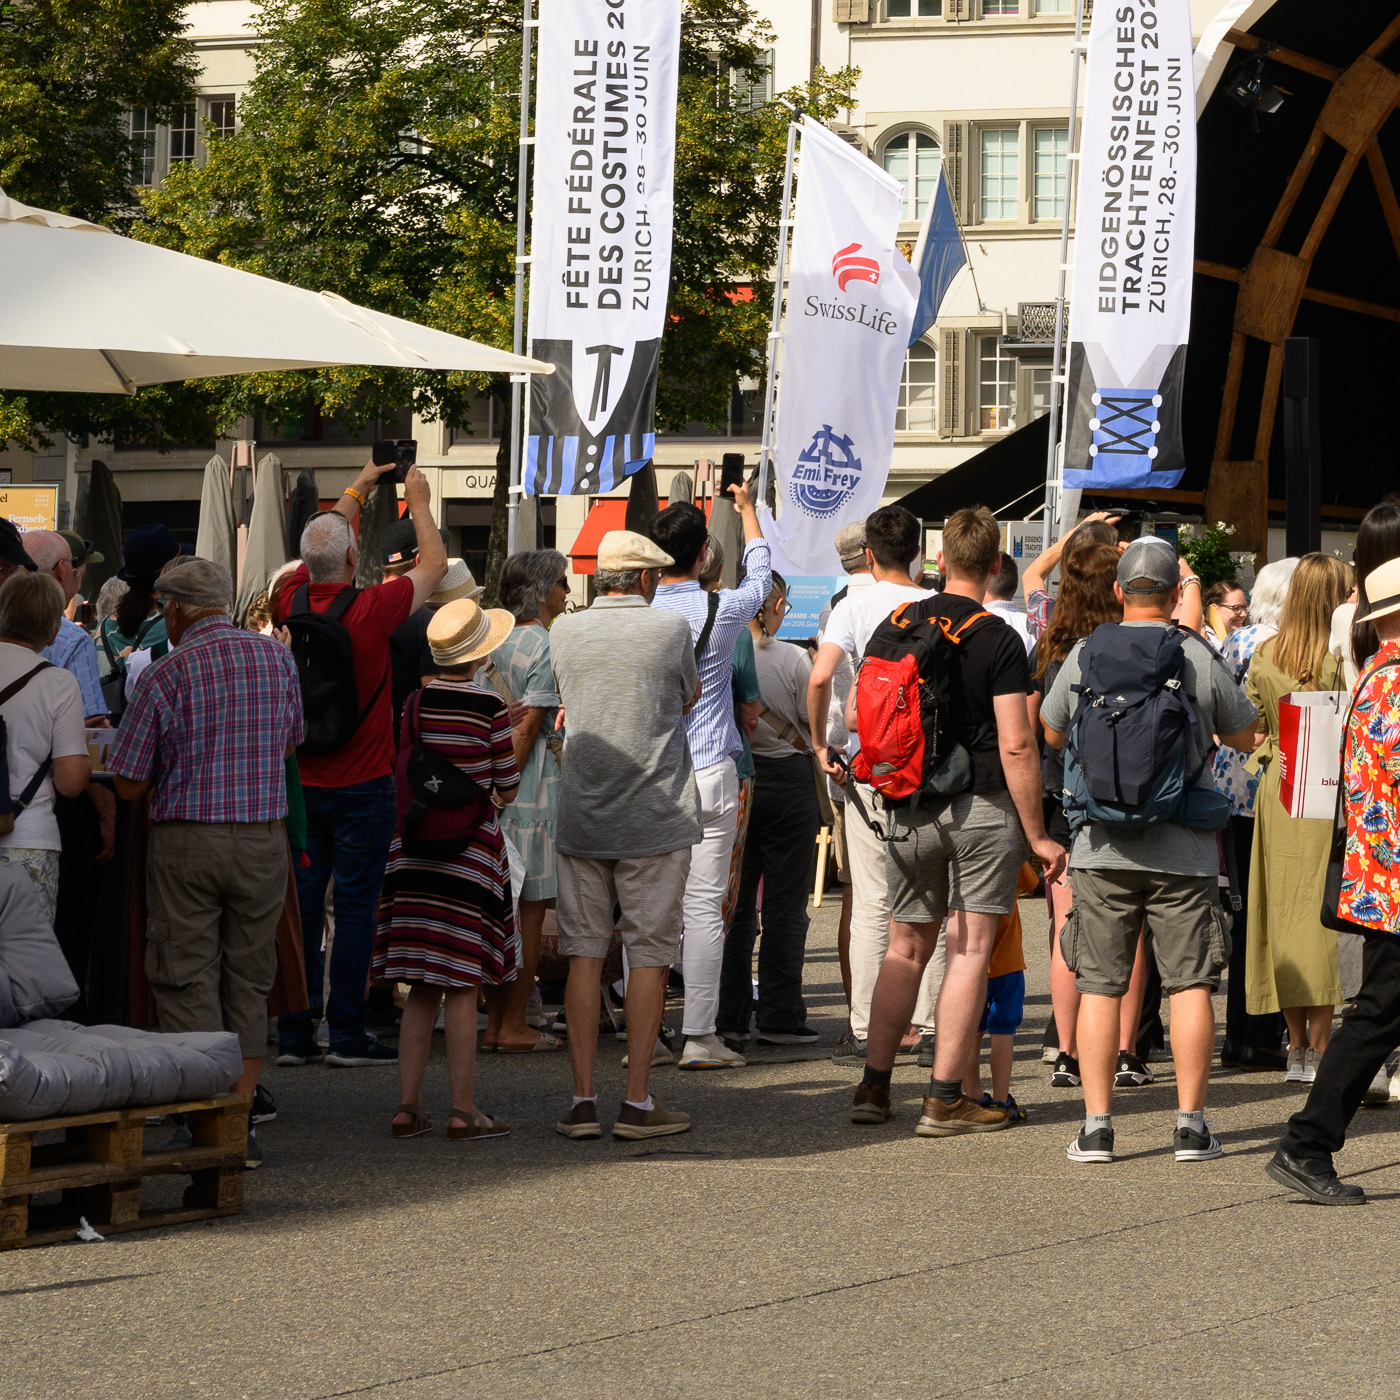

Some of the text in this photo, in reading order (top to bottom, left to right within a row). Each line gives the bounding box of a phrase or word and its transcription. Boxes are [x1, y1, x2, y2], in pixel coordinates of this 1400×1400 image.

[600, 39, 630, 235] COSTUMES
[632, 44, 652, 108] JUIN
[561, 38, 600, 309] FÊTE FÉDÉRALE
[1098, 5, 1136, 314] EIDGENÖSSISCHES
[1121, 60, 1160, 315] TRACHTENFEST
[597, 243, 625, 310] DES
[1148, 211, 1176, 314] ZÜRICH,
[823, 466, 861, 490] Frey
